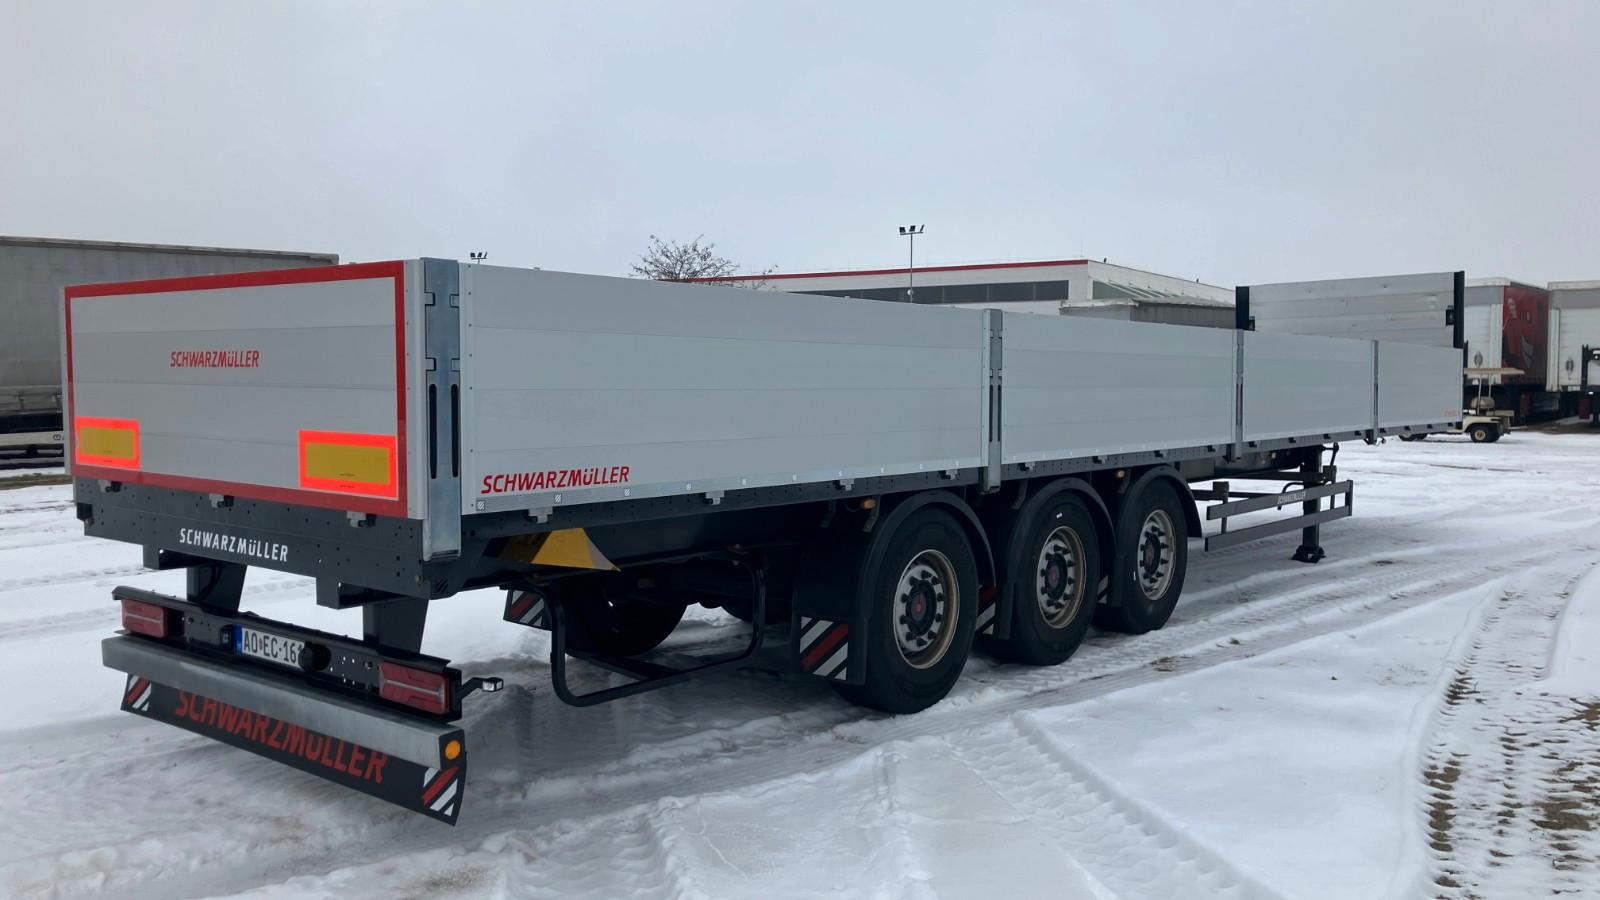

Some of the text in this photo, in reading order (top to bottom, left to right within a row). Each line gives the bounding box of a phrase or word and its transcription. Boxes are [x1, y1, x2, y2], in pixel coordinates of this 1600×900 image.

[170, 350, 260, 368] SCHWARZMÜLLER
[481, 466, 630, 494] SCHWARZMÜLLER
[179, 528, 289, 562] SCHWARZMÜLLER
